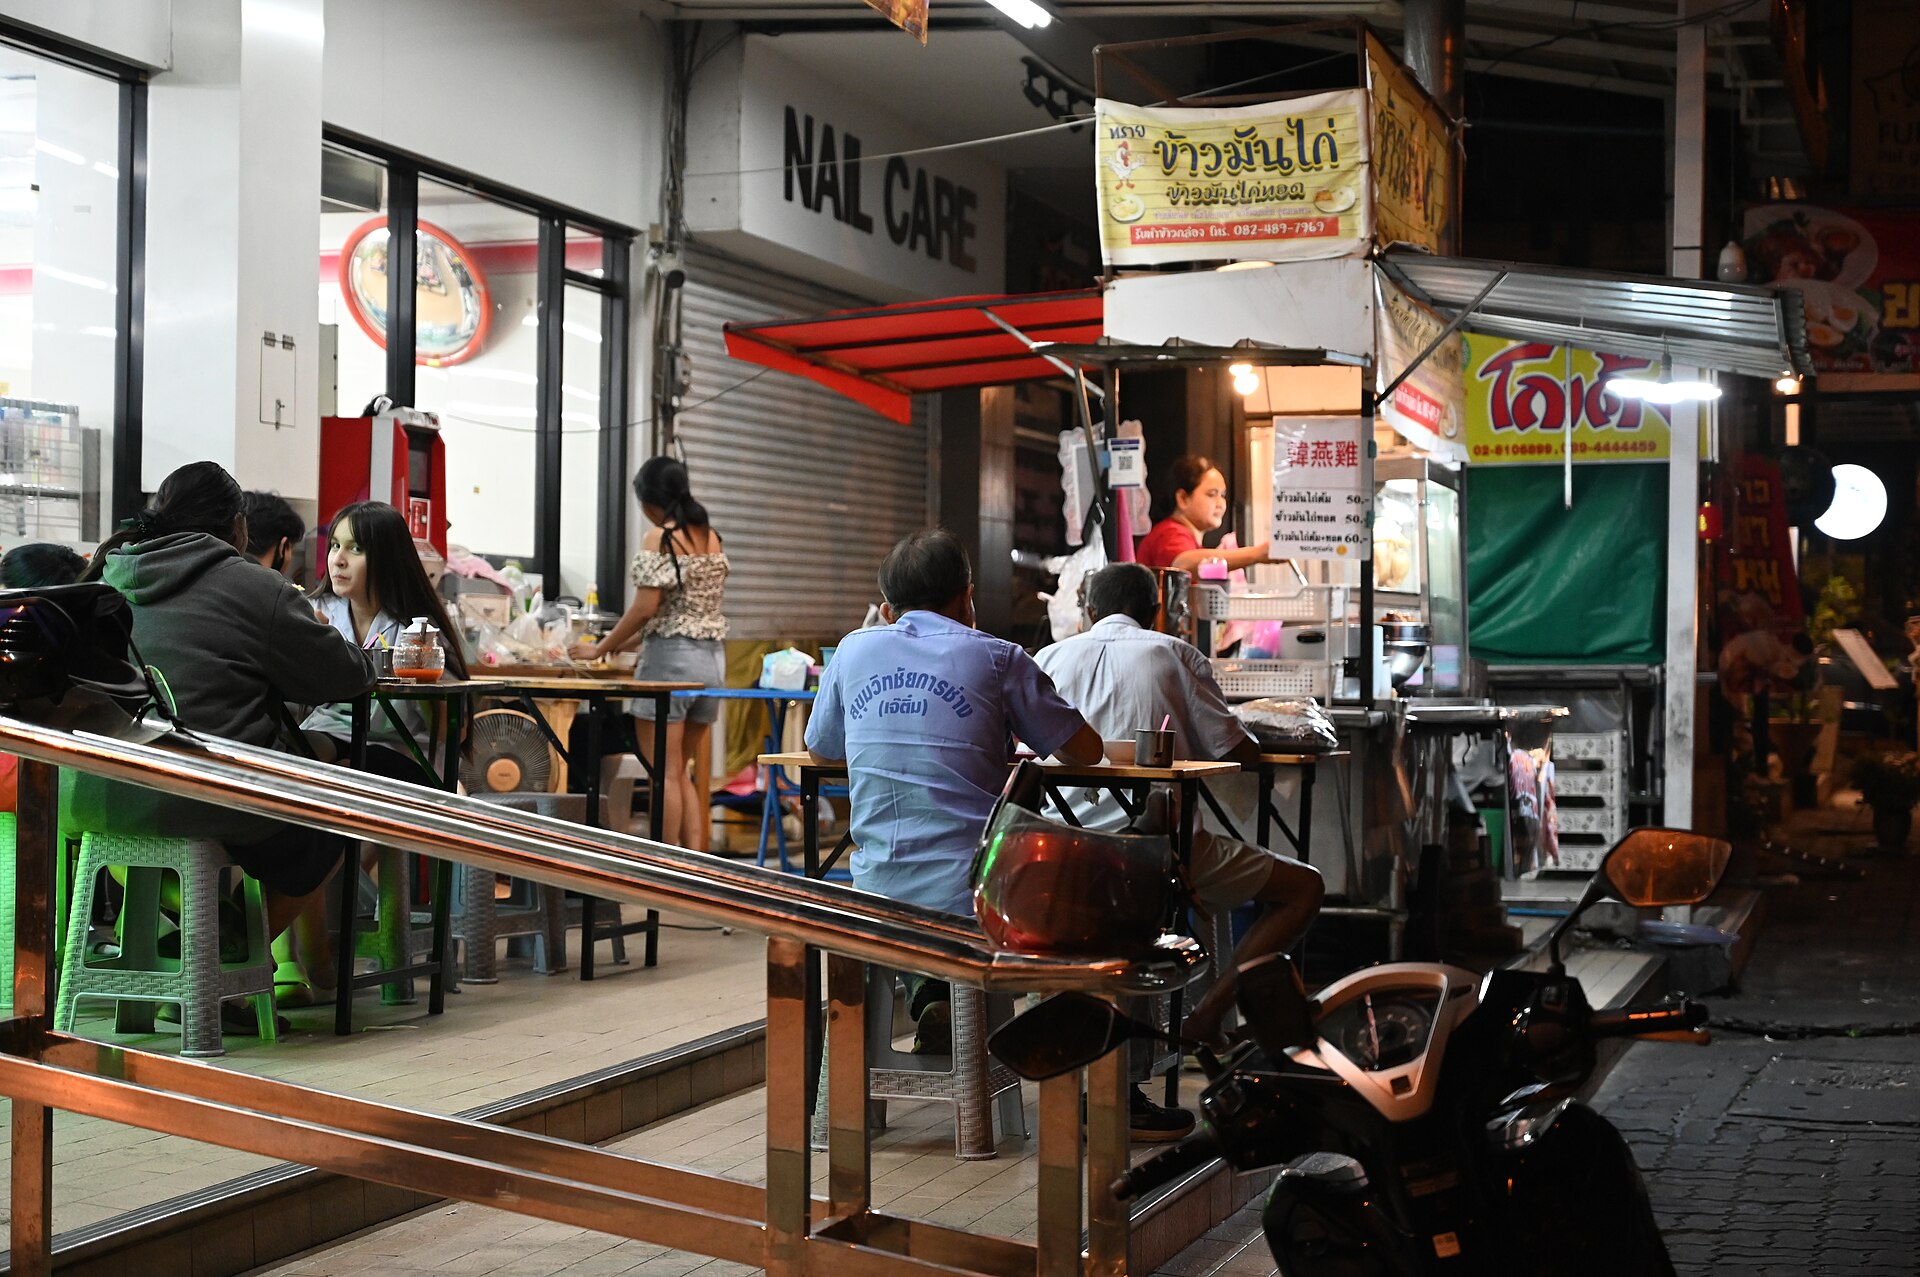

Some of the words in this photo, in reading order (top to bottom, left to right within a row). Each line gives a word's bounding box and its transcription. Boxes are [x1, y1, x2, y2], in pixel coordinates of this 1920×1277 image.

[1109, 124, 1145, 139] ทราย
[1154, 116, 1340, 174] ข้าวมันไก่
[784, 104, 873, 235] NAIL
[884, 155, 978, 274] CARE
[1167, 180, 1305, 203] ข้าวมันไก่ทอด
[1135, 225, 1204, 240] รับทำข้าวกล่อง
[1209, 224, 1230, 237] โทร.
[1233, 221, 1325, 236] 082-489-7969
[1276, 491, 1332, 503] ข้าวมันไก่ต้ม
[1275, 510, 1336, 523] ข้าวมันไก่ทอด
